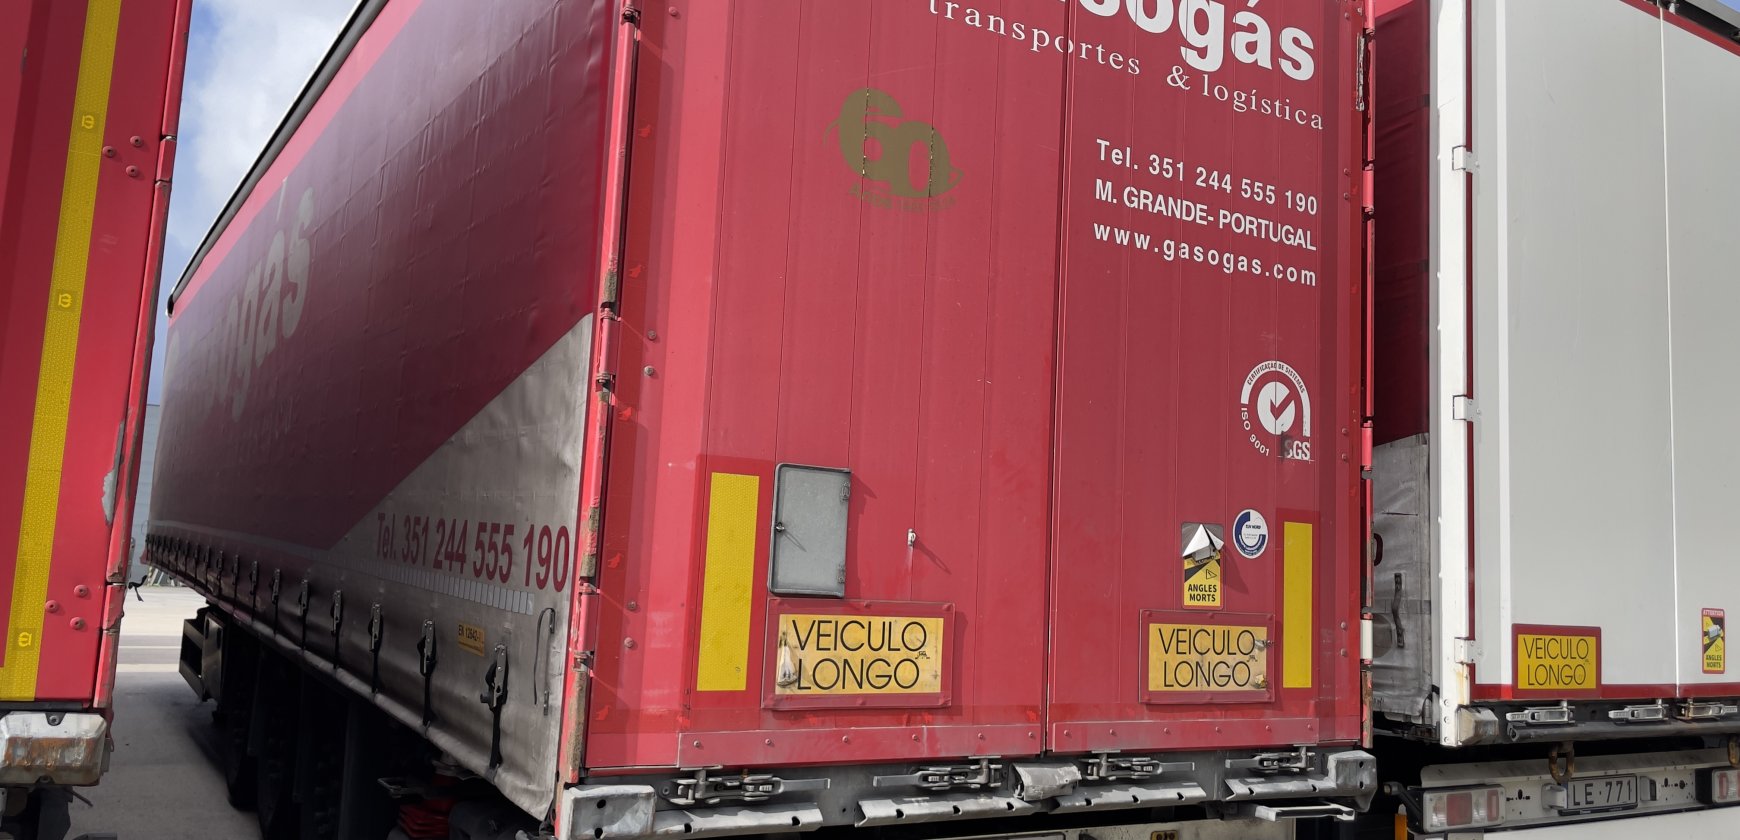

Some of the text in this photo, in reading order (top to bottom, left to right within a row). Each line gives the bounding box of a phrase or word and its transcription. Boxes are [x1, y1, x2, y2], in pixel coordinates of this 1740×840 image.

[928, 0, 1323, 130] transportes & logística
[1096, 138, 1317, 215] Tel. 351 244 555 190
[1095, 178, 1317, 251] M. GRANDE- PORTUGAL
[1093, 223, 1316, 287] www.gasogas.com
[1278, 363, 1285, 371] DE
[1285, 367, 1305, 393] SISTEMAS
[1241, 407, 1270, 456] ISO 9001
[377, 512, 570, 592] Tel. 351 244 555 190
[1188, 584, 1217, 592] ANGLES
[1189, 593, 1216, 602] MORTS
[792, 620, 927, 652] VEICULO
[1158, 628, 1255, 656] VEICULO
[1523, 637, 1589, 659] VEICULO
[797, 658, 920, 690] LONGO
[1163, 660, 1250, 688] LONGO
[1527, 664, 1586, 685] LONGO
